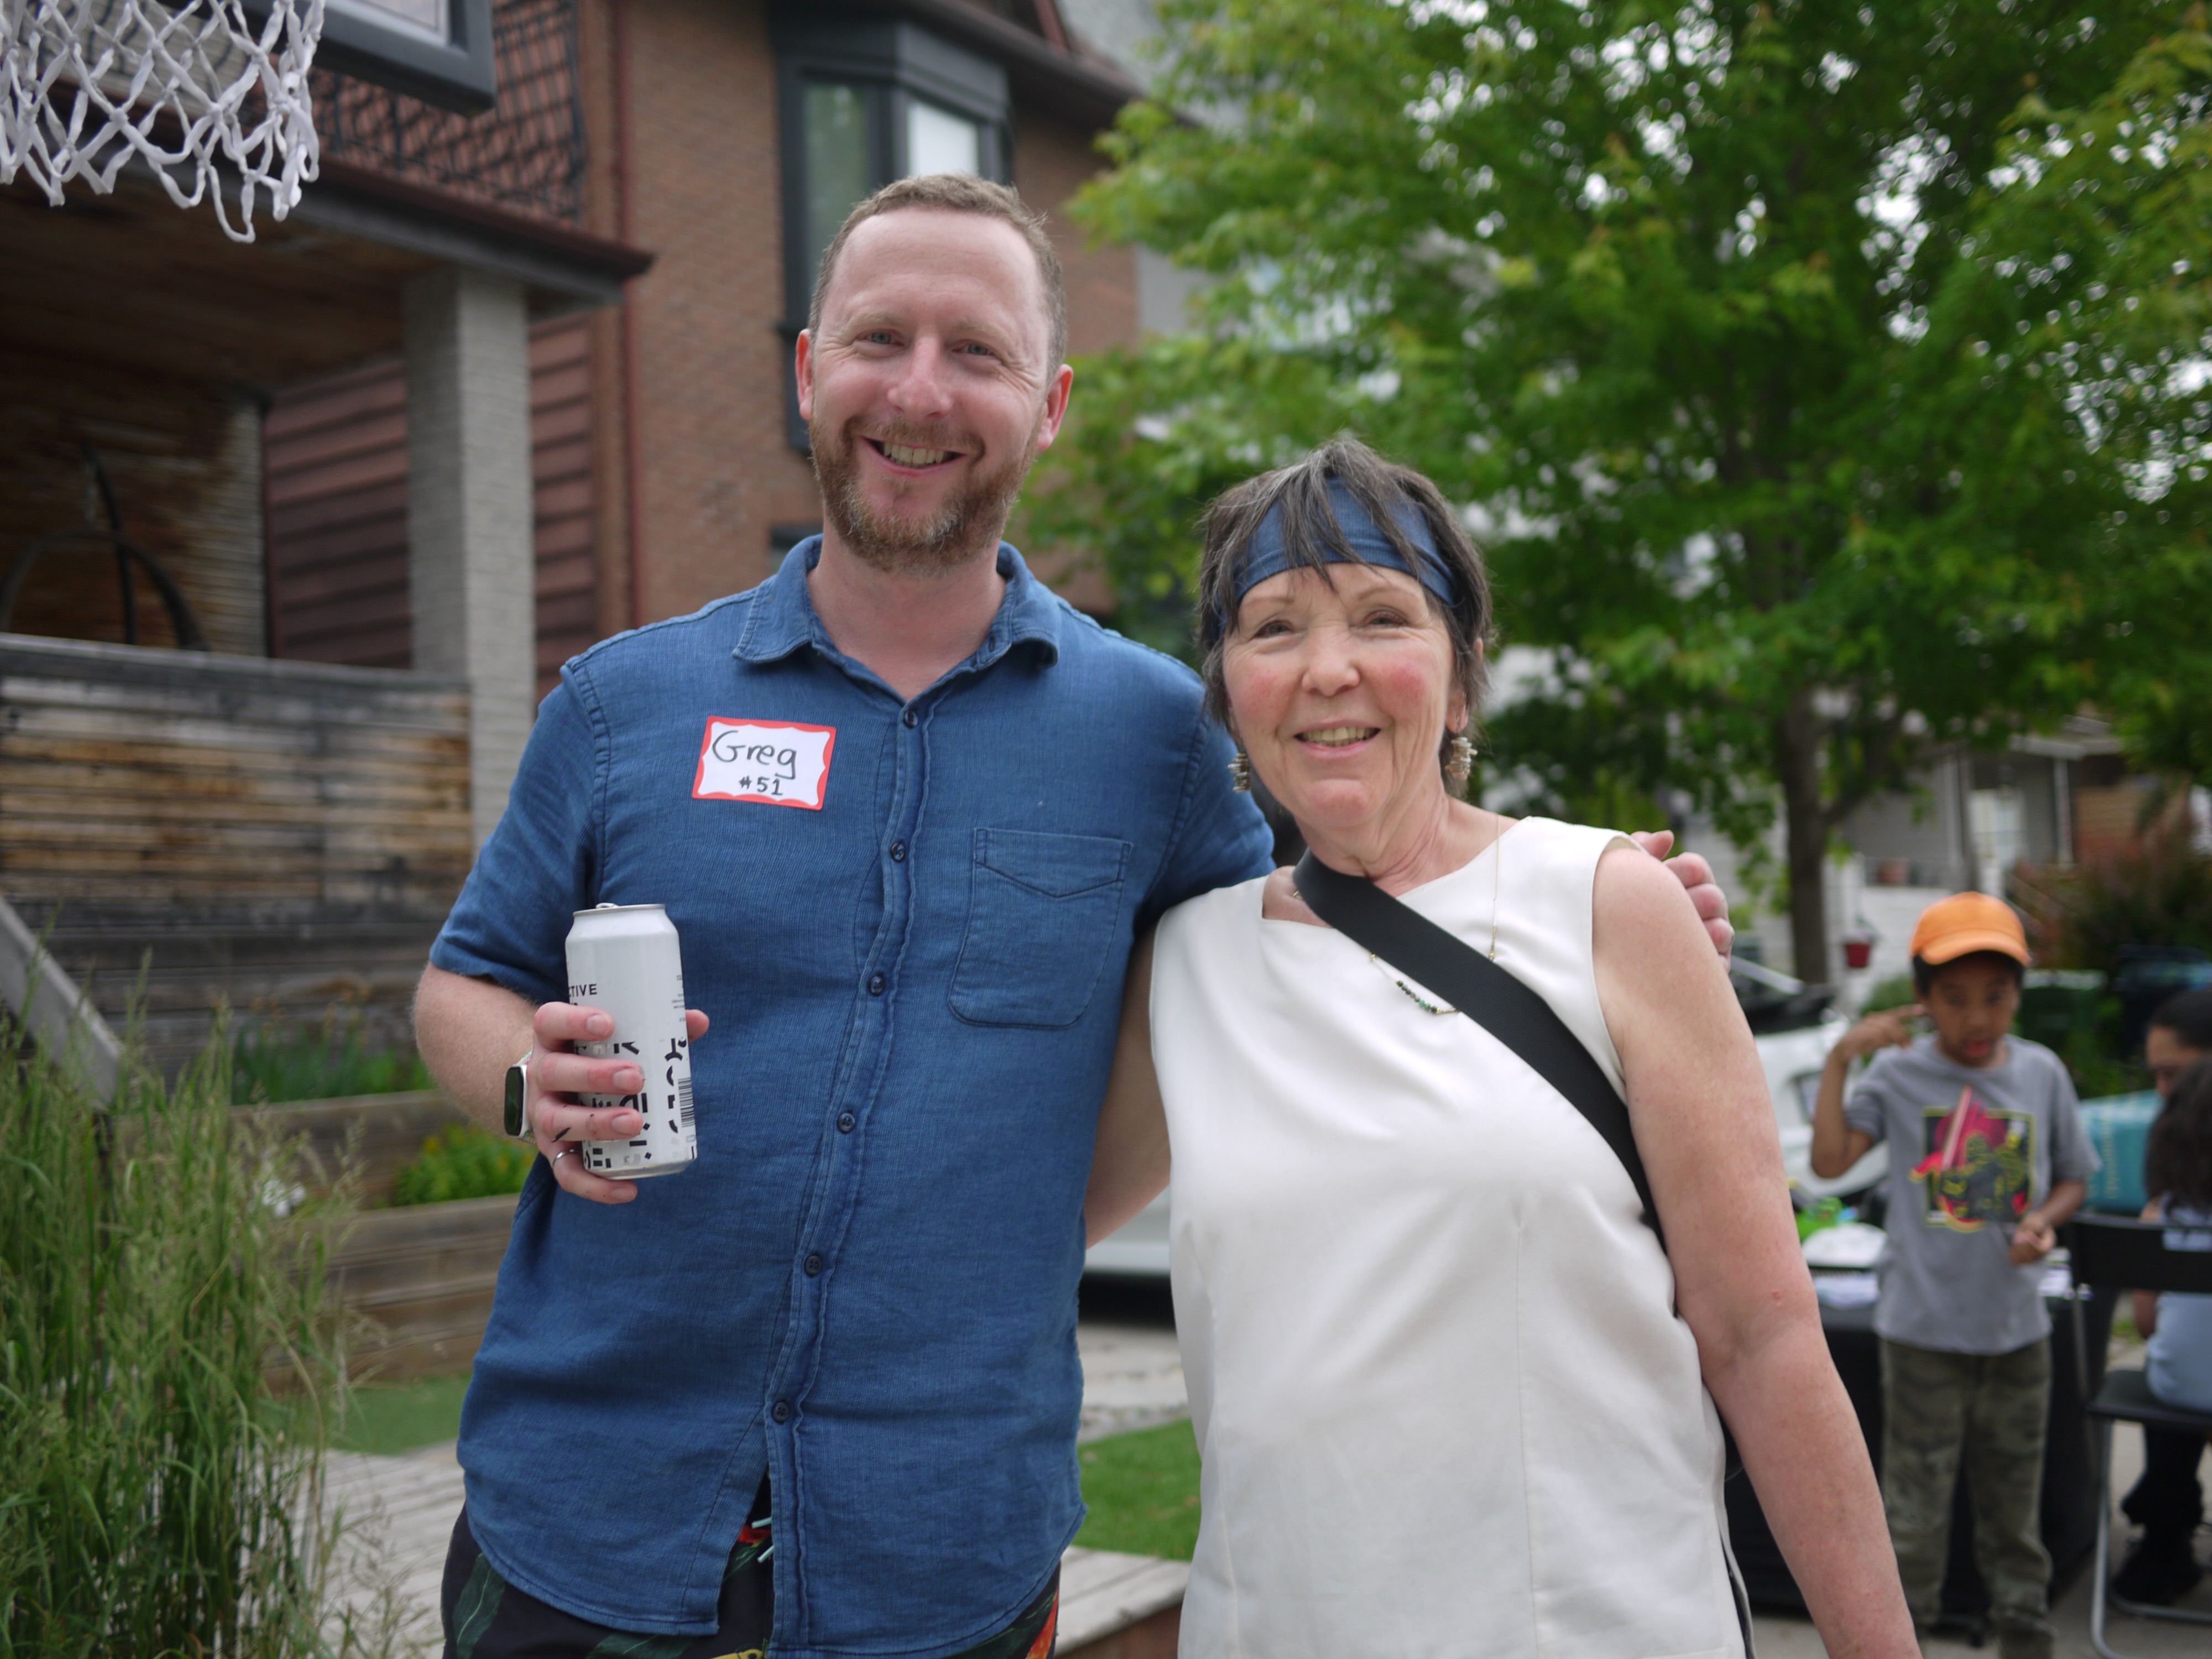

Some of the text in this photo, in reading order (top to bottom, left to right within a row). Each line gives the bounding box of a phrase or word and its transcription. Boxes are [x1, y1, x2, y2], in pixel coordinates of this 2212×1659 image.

[712, 730, 797, 780] Greg
[738, 775, 783, 796] #51
[569, 983, 597, 998] TIVE
